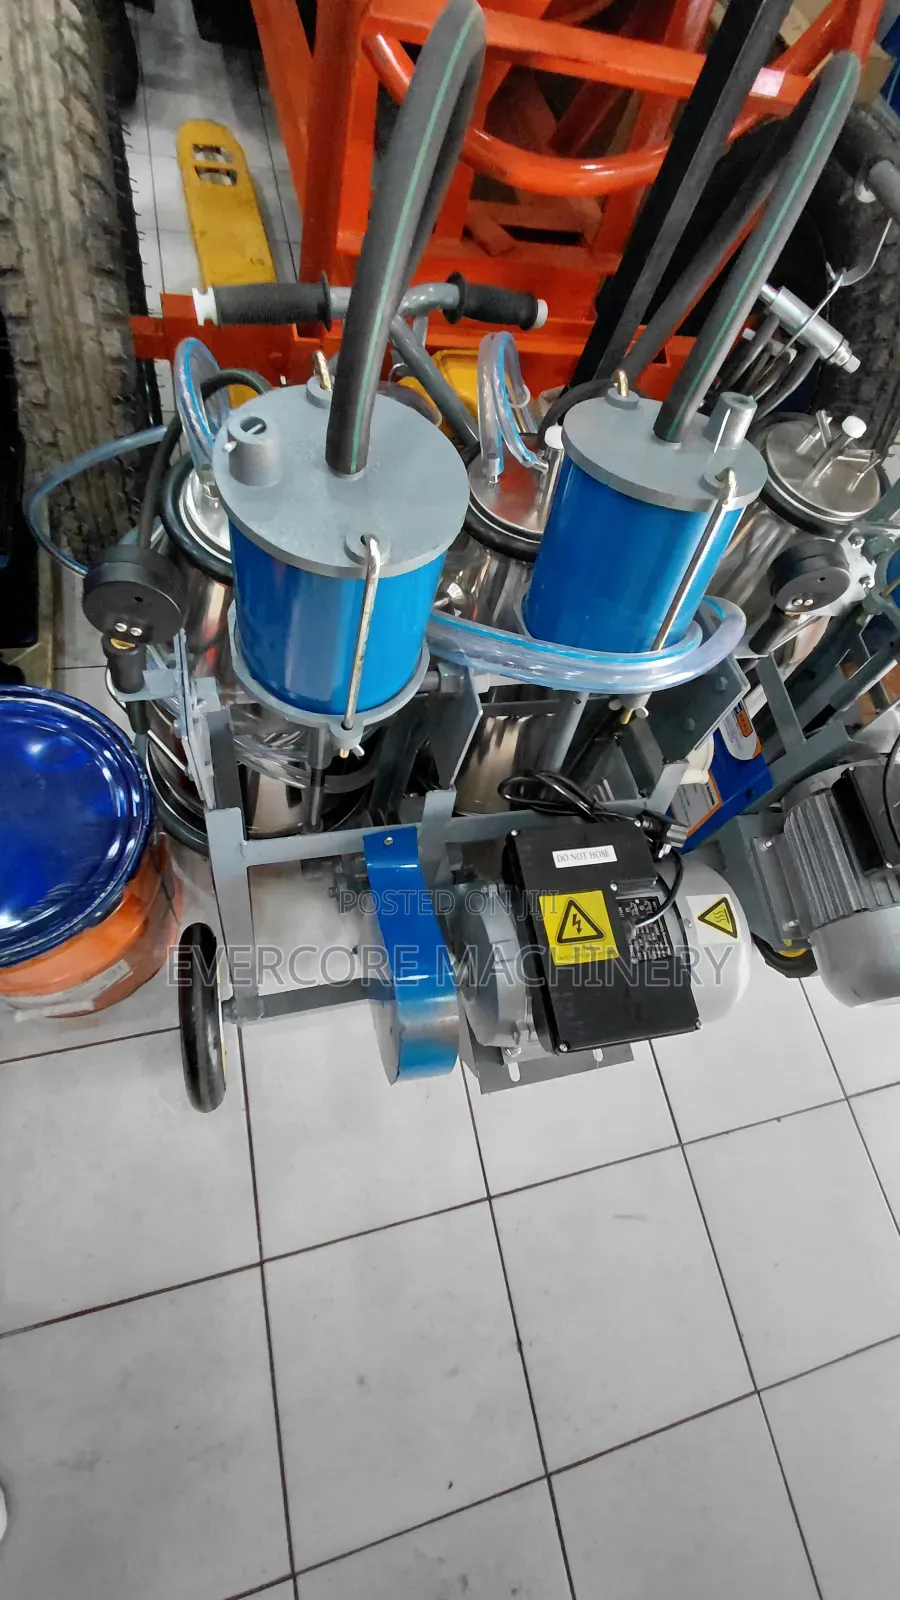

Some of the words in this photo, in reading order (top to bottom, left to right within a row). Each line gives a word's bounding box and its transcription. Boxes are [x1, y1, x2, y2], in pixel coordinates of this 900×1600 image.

[556, 854, 569, 863] DO
[570, 851, 587, 861] NOT
[589, 849, 611, 859] HOSE
